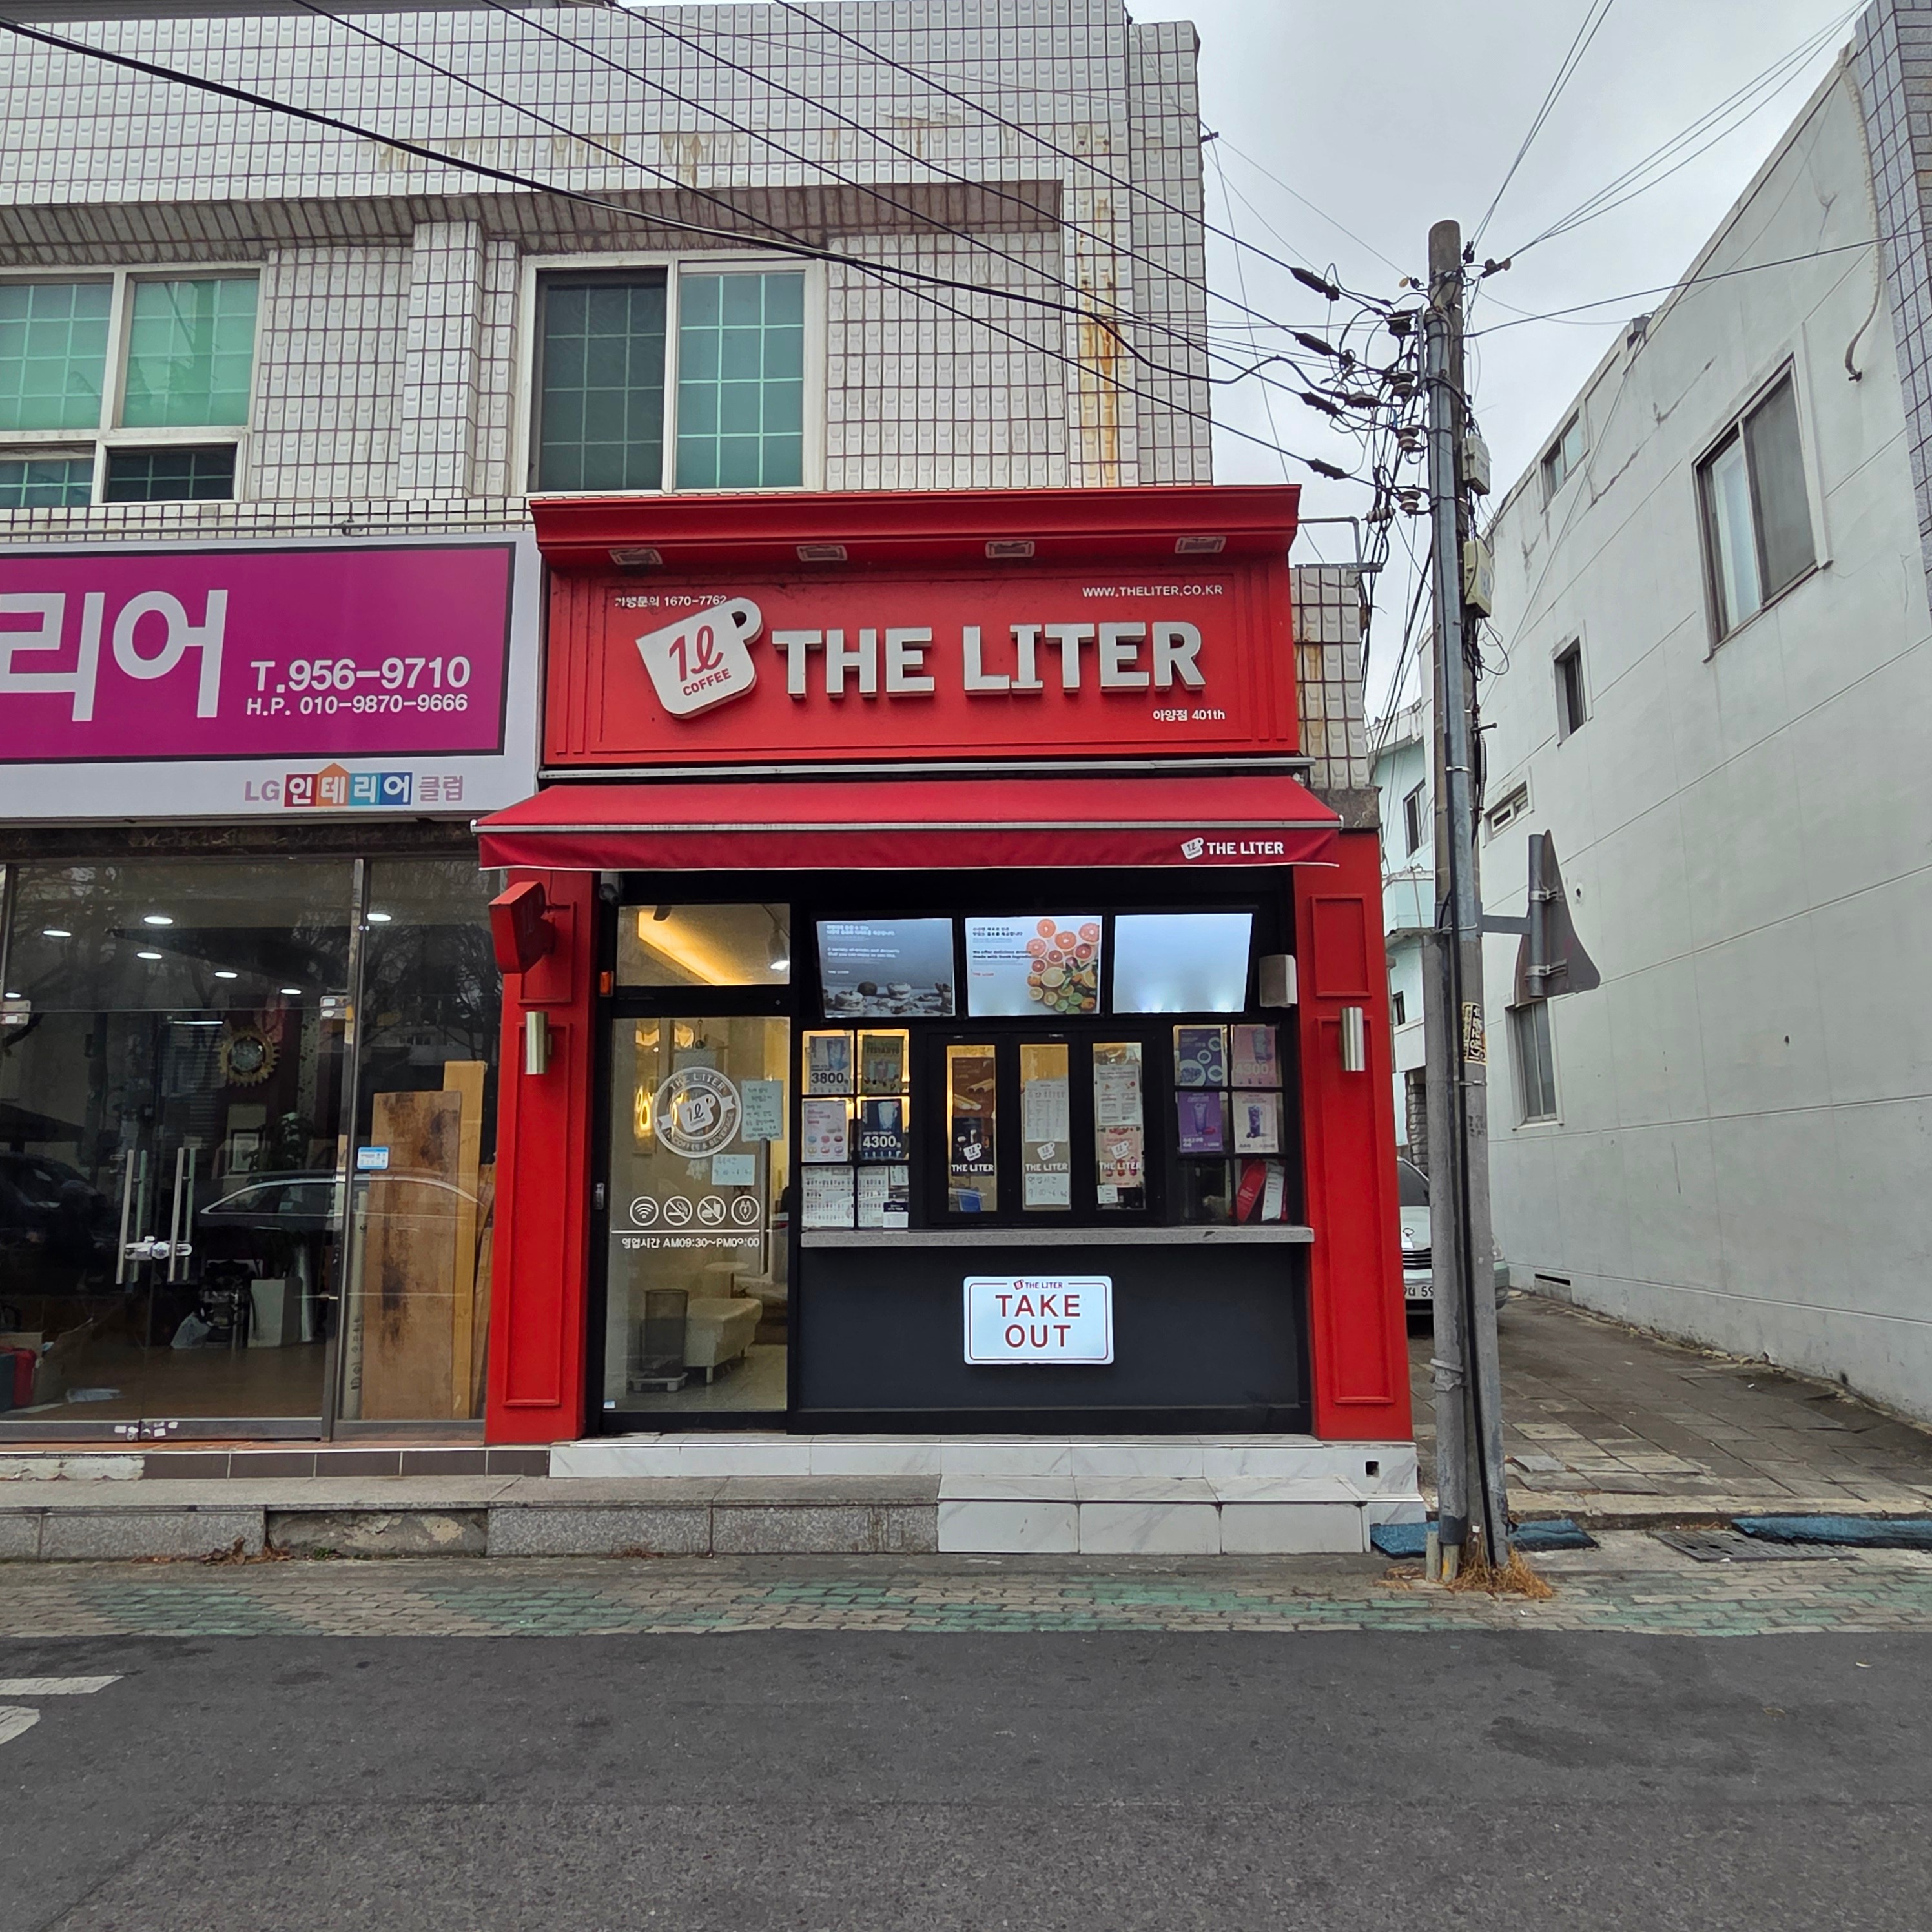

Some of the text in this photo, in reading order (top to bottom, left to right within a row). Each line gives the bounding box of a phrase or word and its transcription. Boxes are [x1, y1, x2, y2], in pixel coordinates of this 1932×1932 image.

[1082, 584, 1223, 597] WWW.THELITER.CO.KR
[664, 595, 727, 606] 1670-7762
[0, 590, 229, 721] 리어
[772, 621, 1206, 699] THE LITER
[251, 656, 471, 693] T.956-9710
[683, 668, 732, 696] COFFEE
[247, 694, 468, 716] H.P. 010-9870-9666
[1153, 709, 1225, 722] 아양점 401th
[419, 775, 463, 802] 클럽
[1206, 841, 1284, 855] THE LITER
[670, 1073, 725, 1091] THE LITER
[811, 1072, 849, 1084] 3800
[951, 1164, 994, 1172] THE LITER
[1025, 1163, 1069, 1171] THE LITER
[1117, 1162, 1142, 1171] LITER
[621, 1238, 661, 1249] 영업시간
[995, 1294, 1080, 1317] TAKE
[1005, 1324, 1071, 1348] OUT
